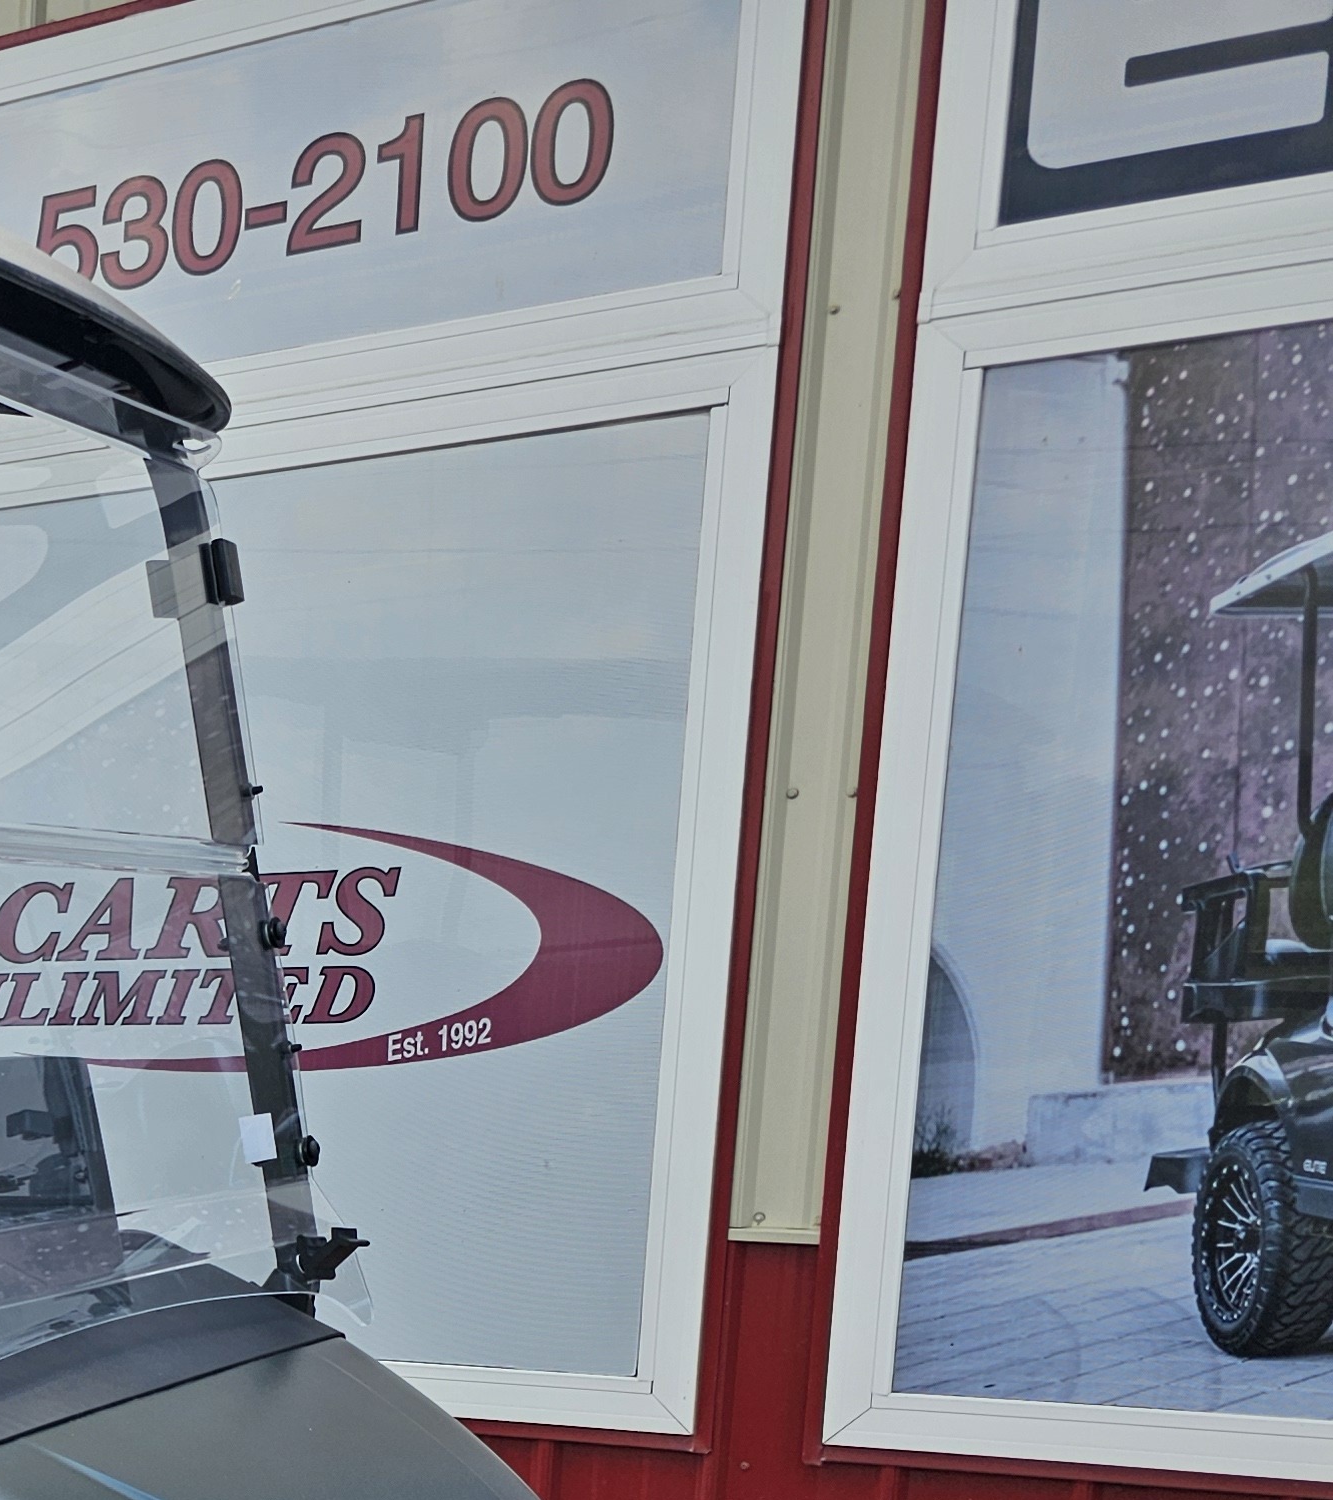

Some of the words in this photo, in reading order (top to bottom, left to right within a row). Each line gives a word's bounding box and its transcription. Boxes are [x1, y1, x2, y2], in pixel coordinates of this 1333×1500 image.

[36, 78, 614, 290] 530-2100
[386, 1031, 429, 1062] Est.
[437, 1017, 493, 1052] 1992
